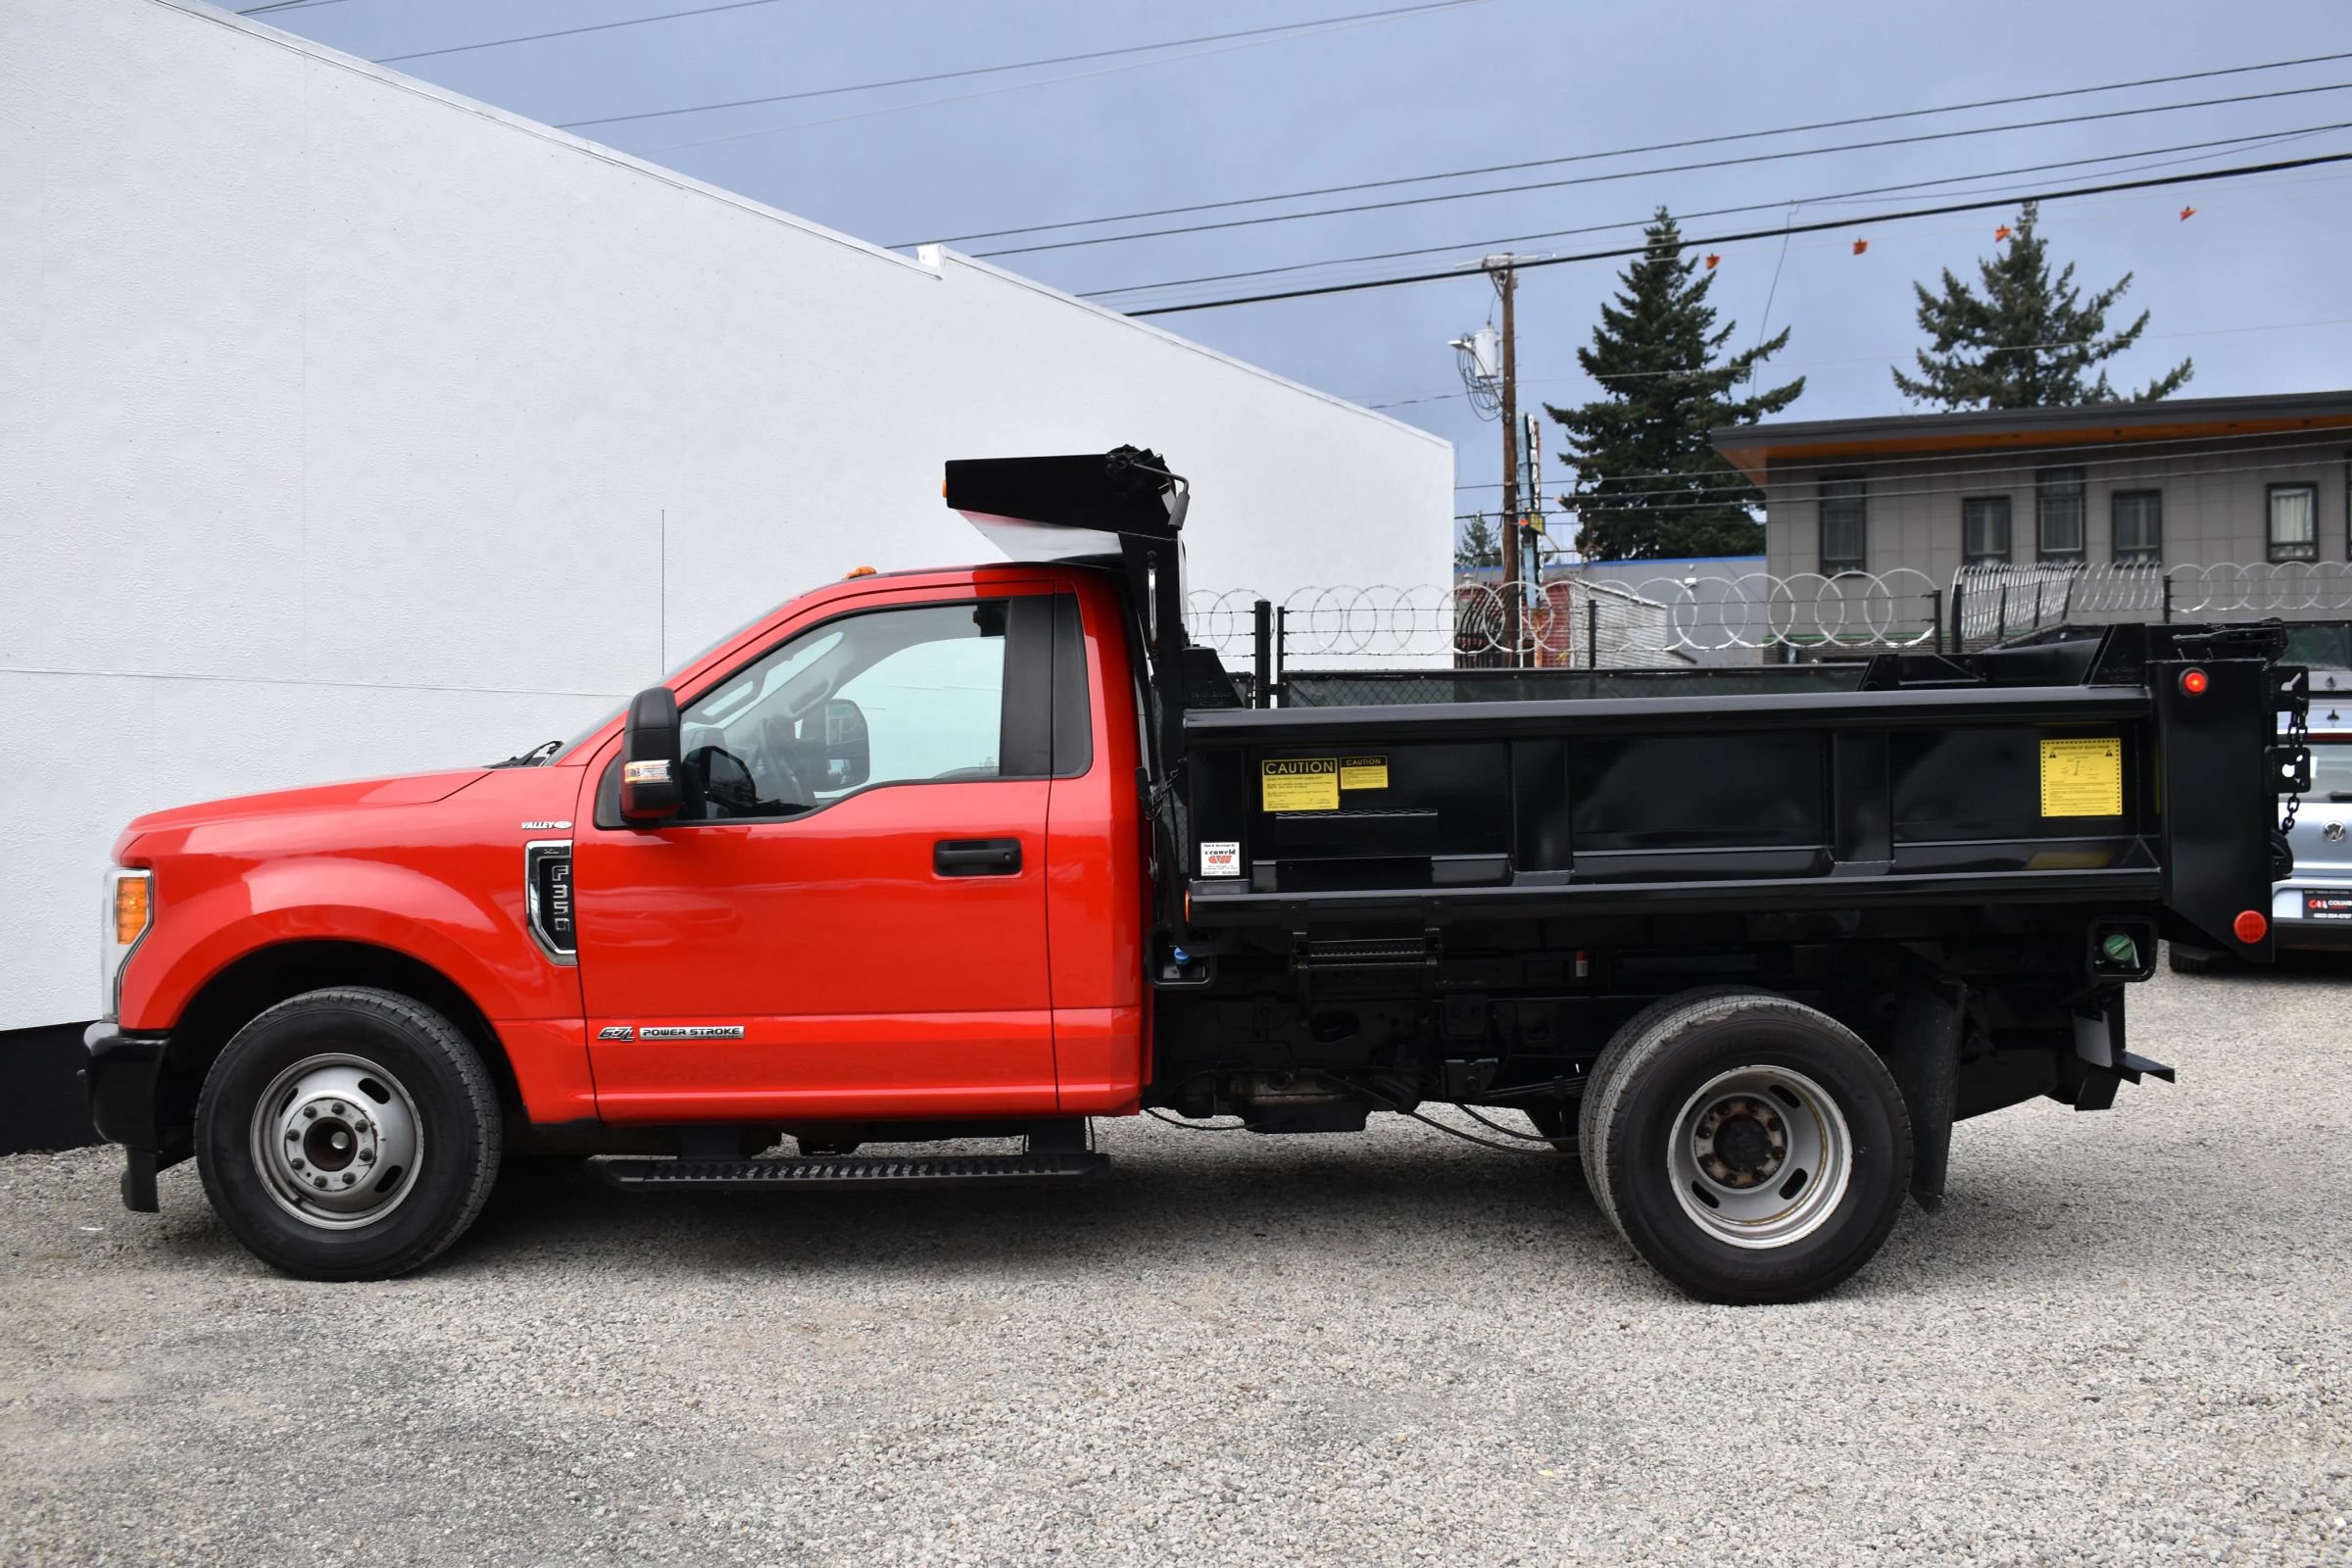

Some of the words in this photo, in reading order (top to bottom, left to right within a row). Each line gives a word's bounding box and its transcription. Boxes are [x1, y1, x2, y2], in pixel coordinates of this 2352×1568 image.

[1265, 760, 1334, 774] CAUTION
[520, 820, 555, 830] VALLEY
[643, 1027, 687, 1037] POWER
[689, 1027, 741, 1036] STROKE
